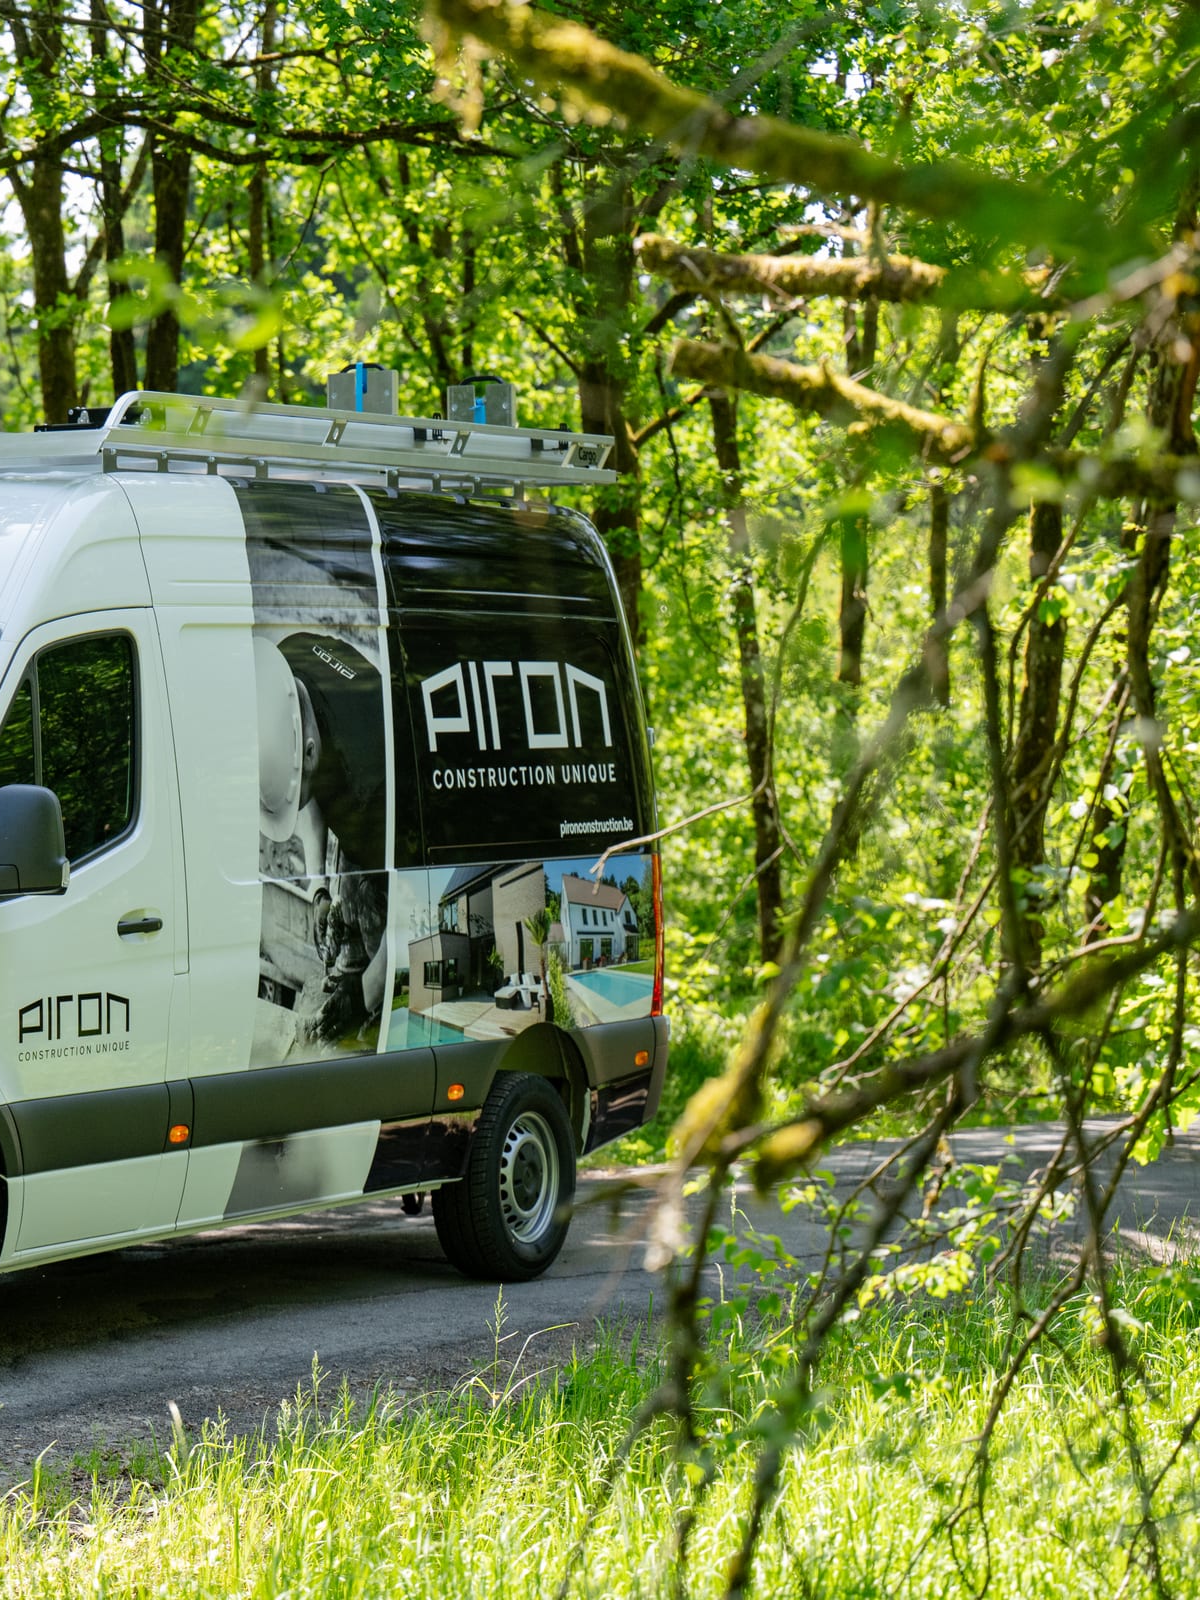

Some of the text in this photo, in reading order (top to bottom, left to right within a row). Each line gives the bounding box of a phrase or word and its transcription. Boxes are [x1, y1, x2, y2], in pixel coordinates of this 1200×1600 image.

[433, 763, 617, 790] CONSTRUCTION UNIQUE
[559, 816, 634, 838] pironconstruction.be
[18, 1041, 130, 1062] CONSTRUCTION UNIQUE
